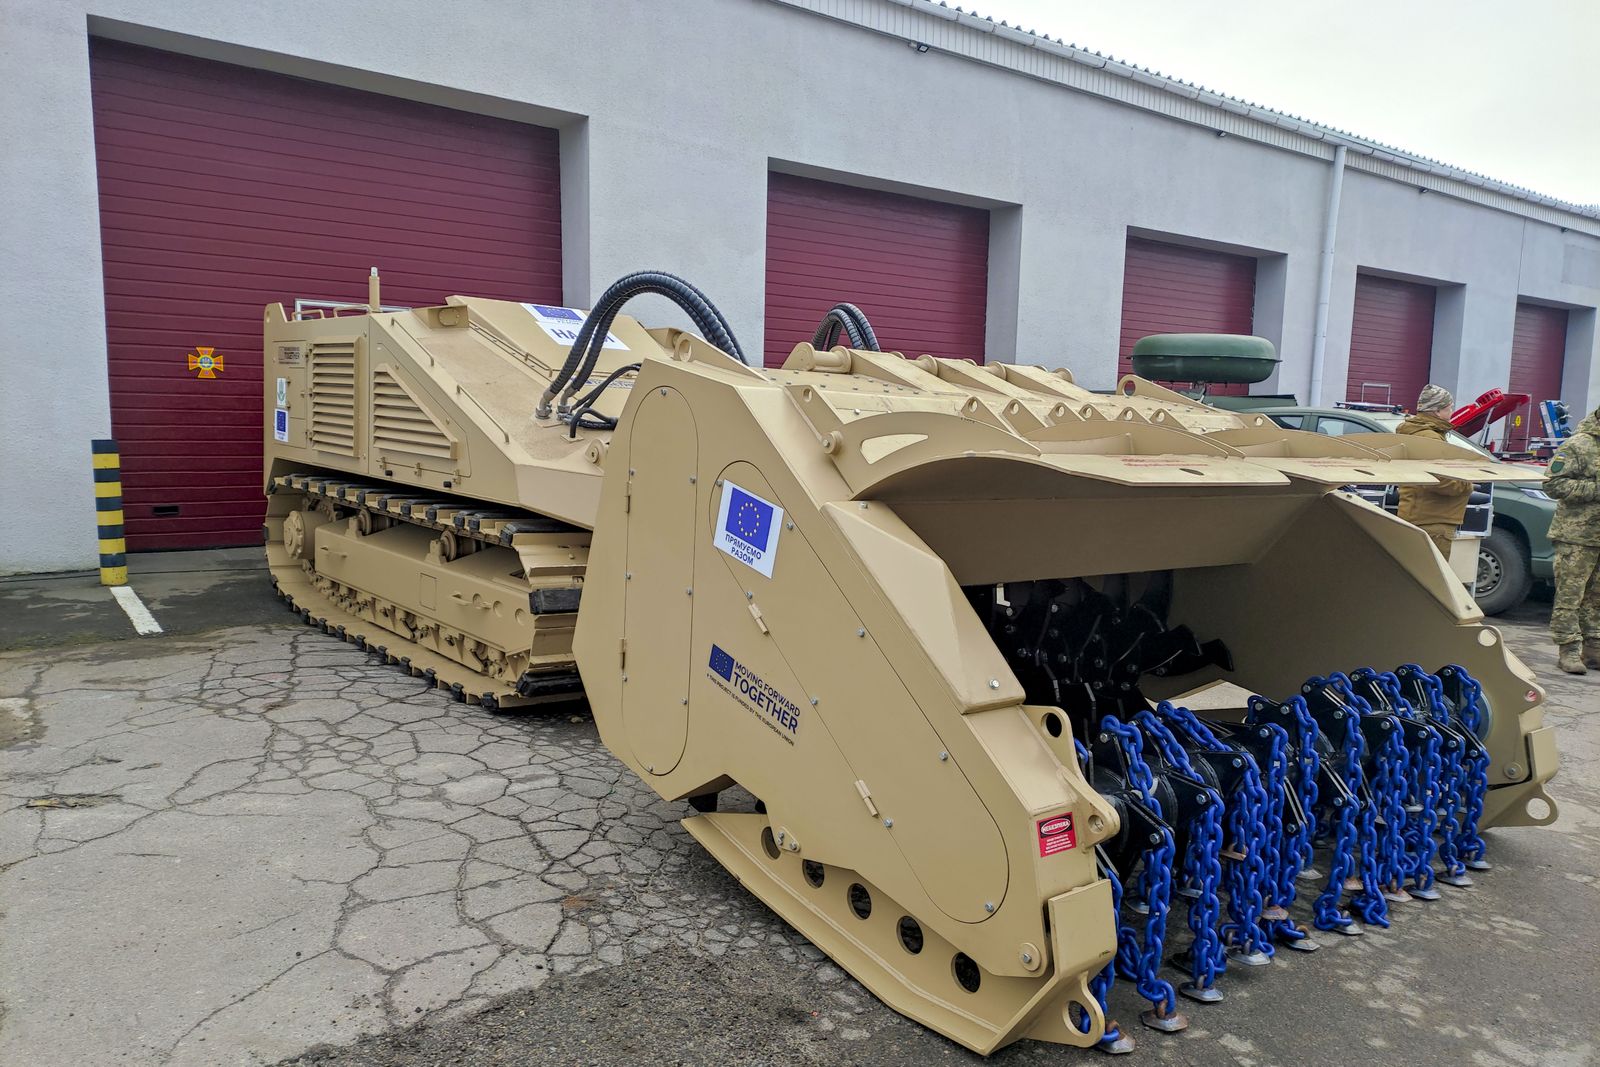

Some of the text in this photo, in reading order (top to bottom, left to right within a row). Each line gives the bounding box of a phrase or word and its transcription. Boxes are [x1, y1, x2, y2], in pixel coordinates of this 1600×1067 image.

[725, 533, 762, 560] ПРЯМУЄМО
[731, 547, 754, 566] РАЗОМ
[734, 661, 800, 717] MOVING FORWARD
[734, 671, 798, 735] TOGETHER
